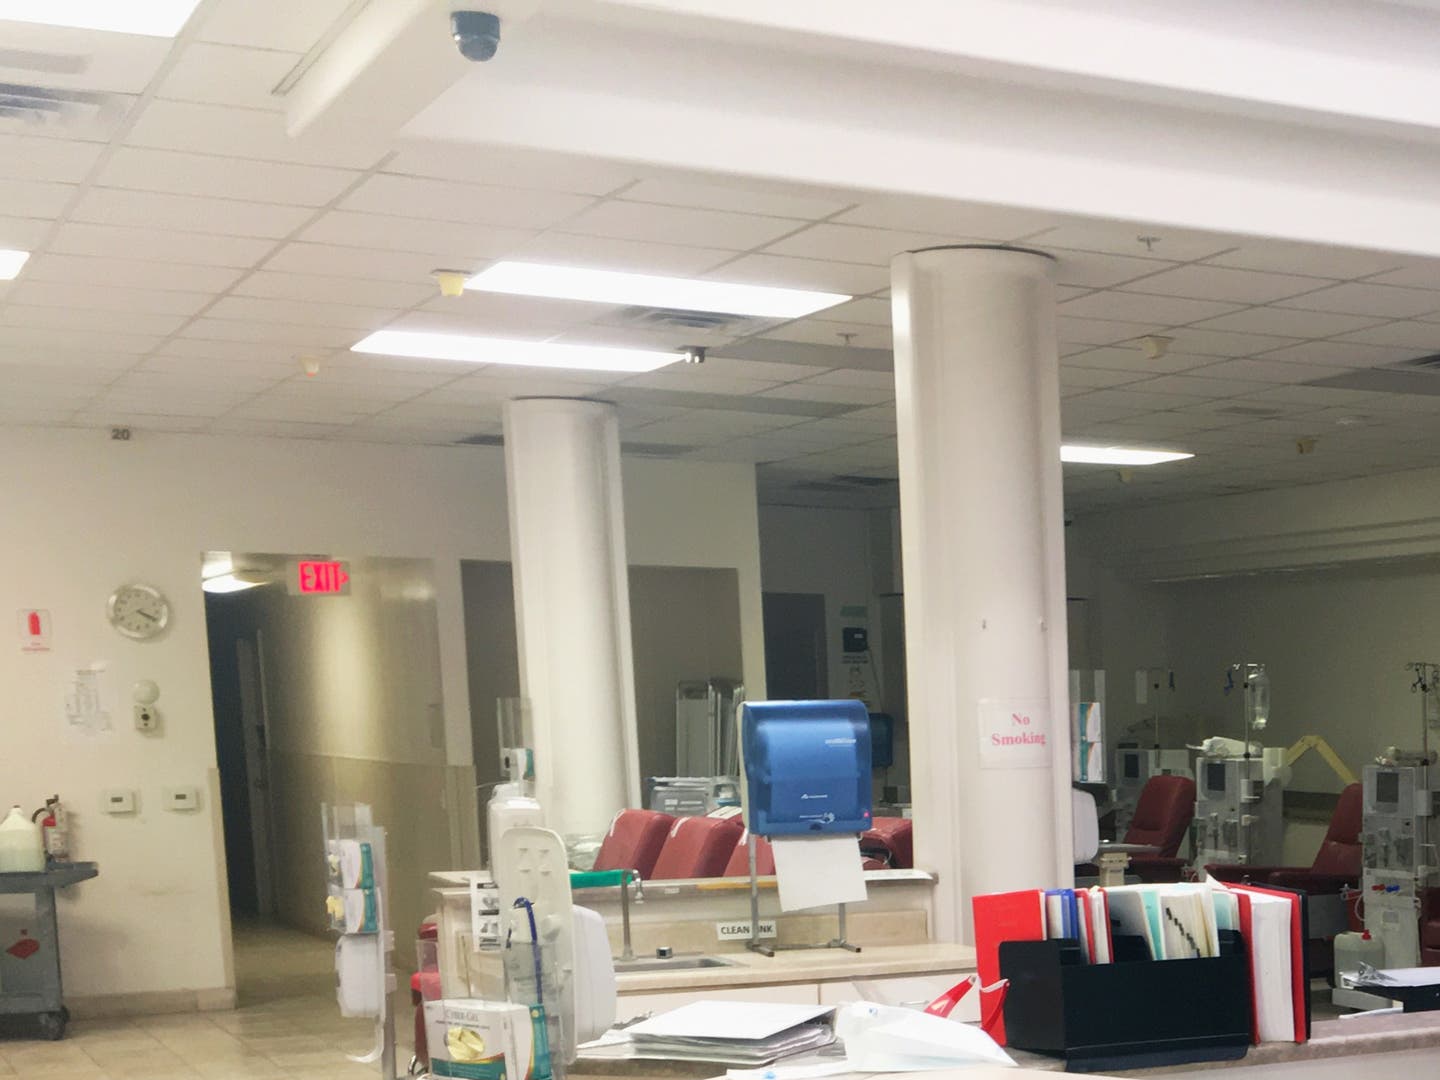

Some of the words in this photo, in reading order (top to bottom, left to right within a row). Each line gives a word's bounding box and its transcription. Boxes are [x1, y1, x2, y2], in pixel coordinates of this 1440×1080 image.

[299, 562, 341, 593] EXIT
[1011, 713, 1030, 726] No
[991, 733, 1046, 748] Smoking
[720, 926, 750, 935] CLEAN
